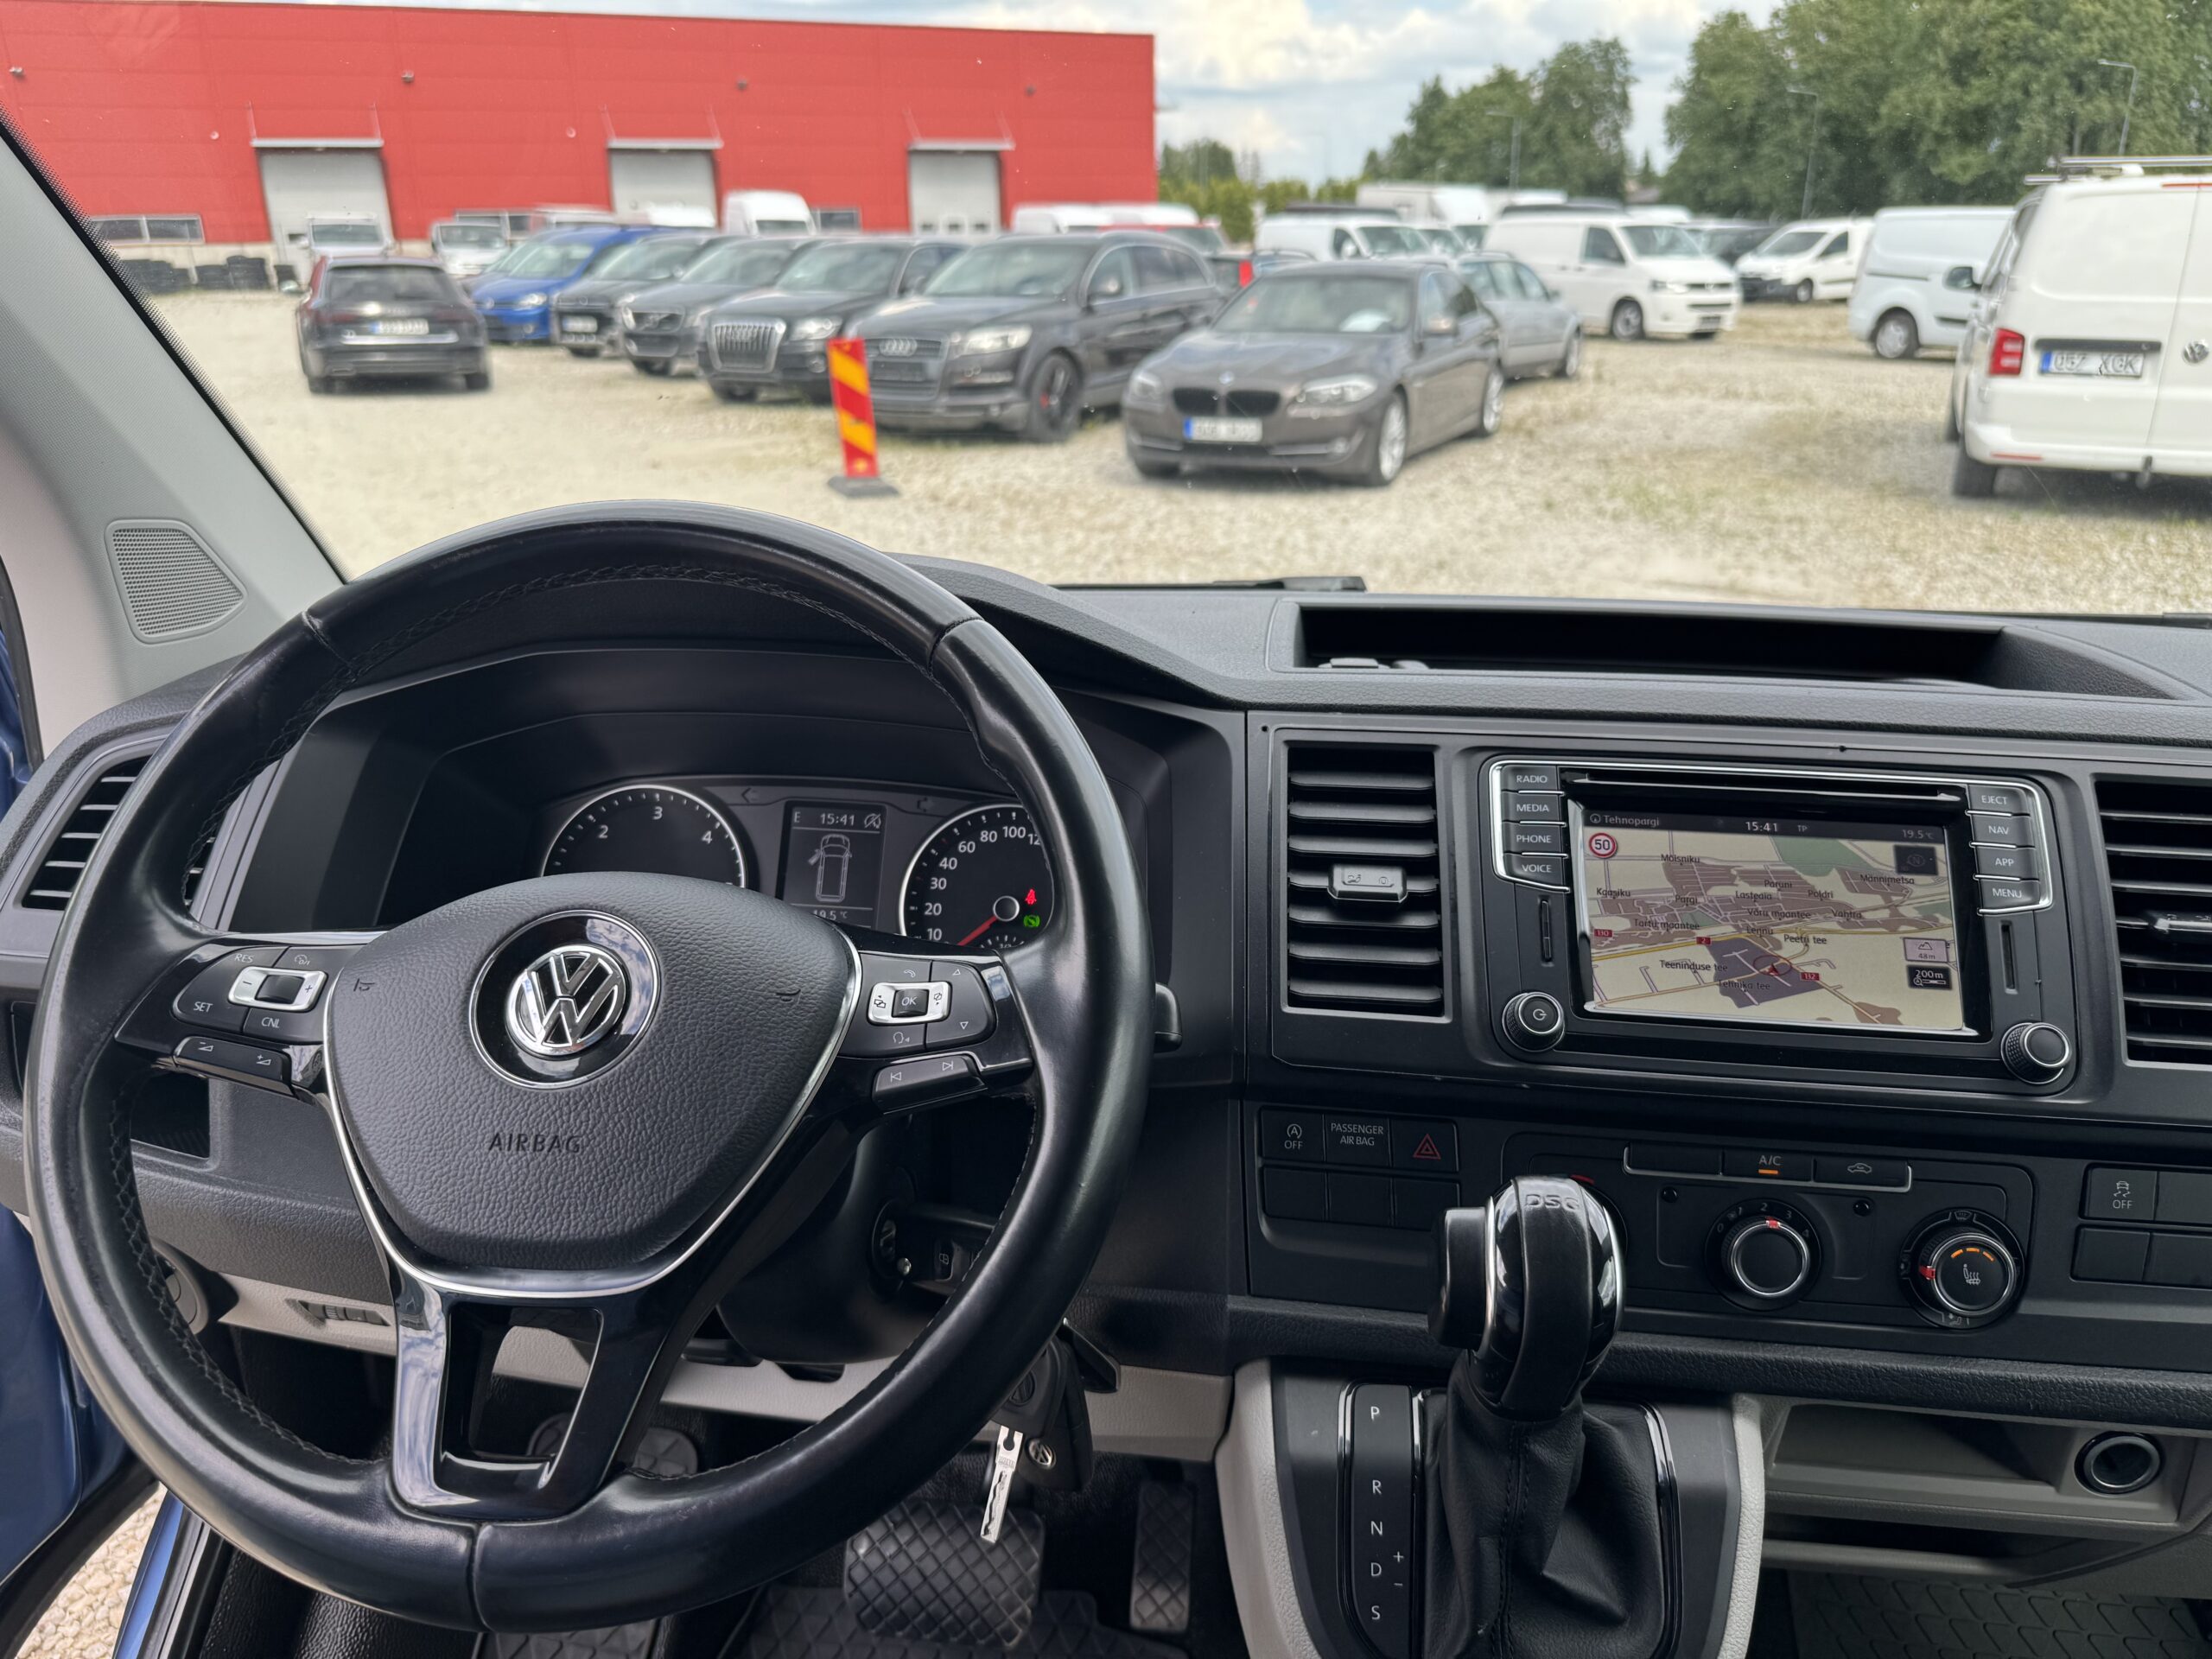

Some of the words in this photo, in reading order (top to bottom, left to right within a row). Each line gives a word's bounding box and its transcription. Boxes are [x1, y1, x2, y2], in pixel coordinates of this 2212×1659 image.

[1516, 775, 1548, 784] RADIO
[1981, 795, 2007, 804] EJECT
[652, 806, 663, 820] 3
[1516, 804, 1549, 812] MEDIA
[821, 813, 855, 826] 15:41
[1605, 815, 1659, 827] Tehnopargi
[598, 825, 609, 839] 2
[1002, 826, 1027, 839] 100
[1745, 822, 1778, 832] 15:41
[1988, 826, 2009, 835] NAV
[702, 830, 713, 844] 4
[980, 830, 998, 842] 80
[1027, 834, 1040, 845] 12
[1516, 835, 1552, 843] PHONE
[958, 841, 976, 853] 60
[1594, 839, 1611, 851] 50
[939, 857, 957, 870] 40
[1522, 864, 1552, 873] VOICE
[930, 877, 947, 891] 30
[1993, 888, 2022, 898] MENU
[925, 902, 942, 916] 20
[927, 928, 942, 941] 10
[1813, 935, 1827, 944] tee
[235, 953, 254, 963] RES
[1659, 959, 1712, 971] Teeninduse
[1713, 963, 1728, 972] tee
[194, 1001, 213, 1013] SET
[901, 996, 918, 1007] OK
[261, 1016, 281, 1028] CNL
[1331, 1122, 1384, 1135] PASSENGER
[488, 1132, 582, 1154] AIRBAG
[1284, 1140, 1303, 1150] OFF
[1758, 1154, 1782, 1166] A/C
[1760, 1202, 1768, 1211] 2
[2113, 1199, 2133, 1209] OFF
[1786, 1210, 1792, 1218] 3
[1370, 1406, 1380, 1420] P
[1372, 1479, 1382, 1495] R
[1370, 1521, 1383, 1536] N
[1370, 1562, 1382, 1577] D
[1371, 1605, 1381, 1621] S
